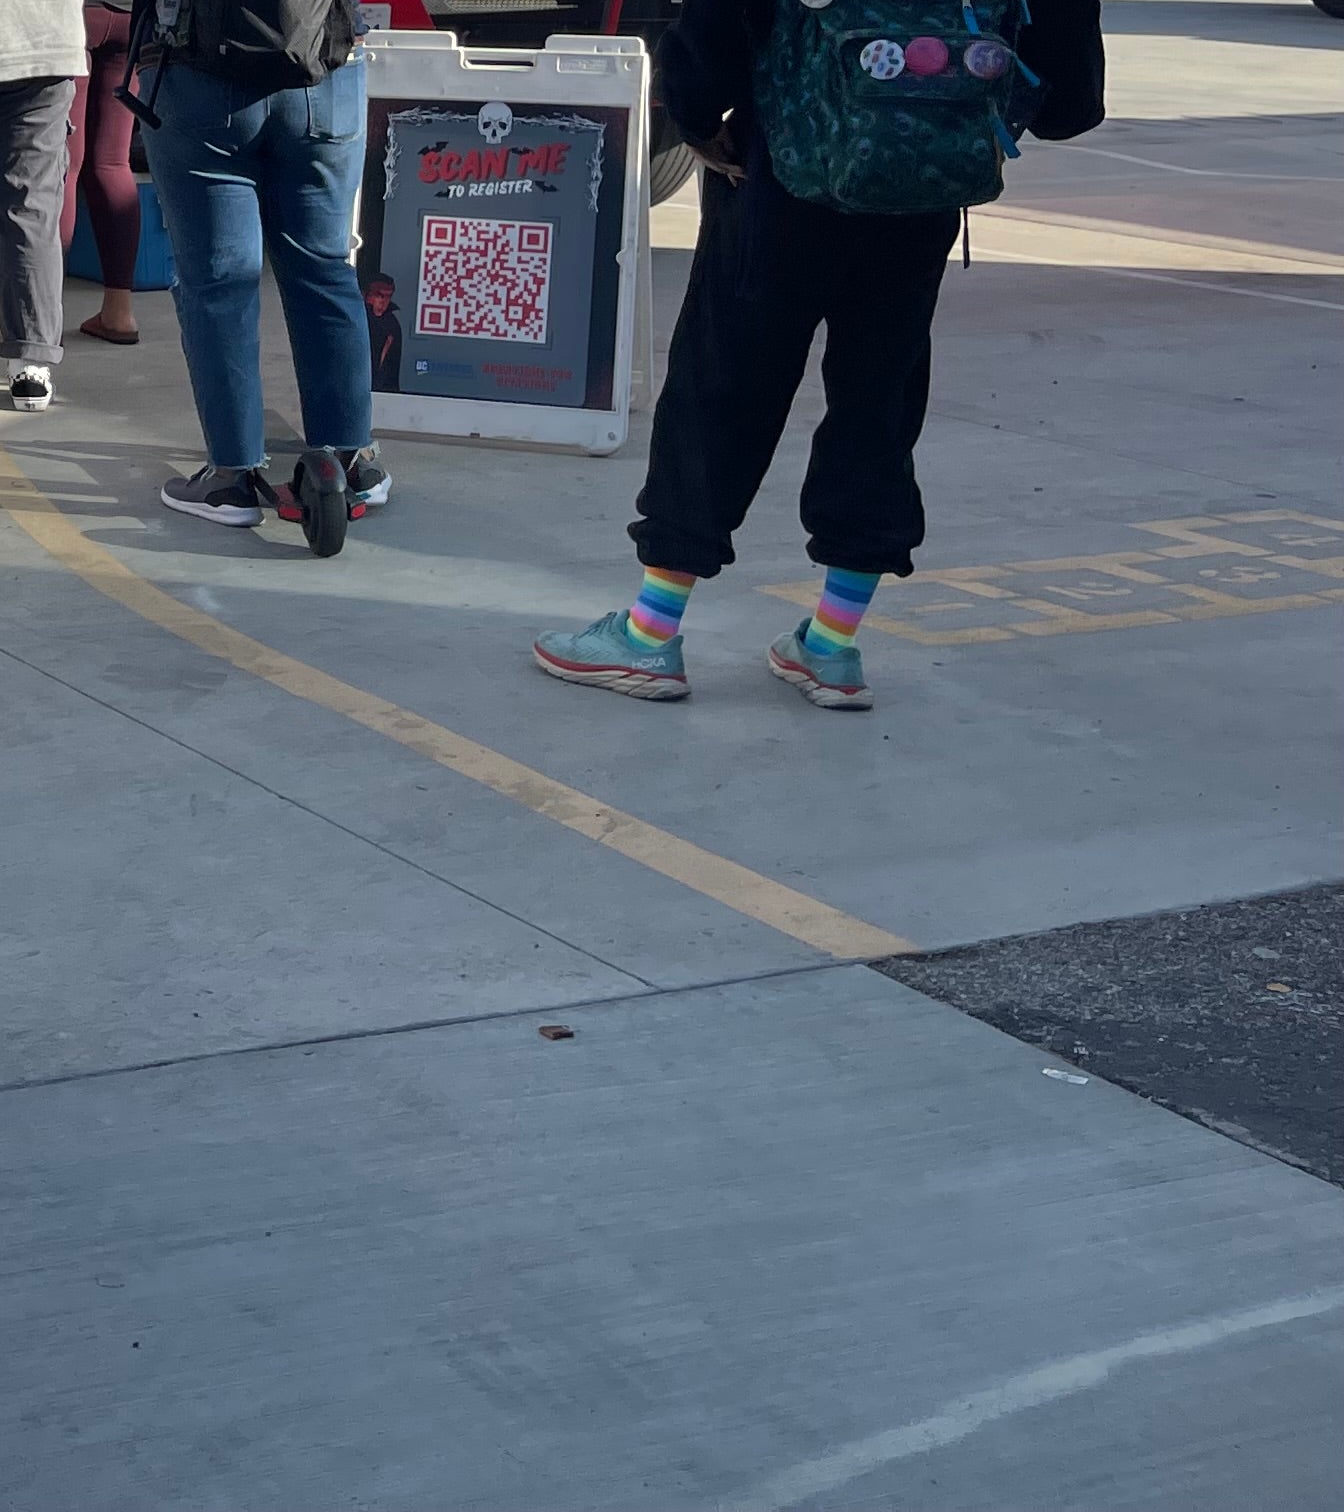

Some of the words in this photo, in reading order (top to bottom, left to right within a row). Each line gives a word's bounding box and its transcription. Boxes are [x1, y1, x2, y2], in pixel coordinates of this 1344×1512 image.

[417, 148, 511, 184] SCAN
[517, 141, 572, 178] ME
[447, 184, 465, 199] TO
[468, 179, 533, 197] REGISTER
